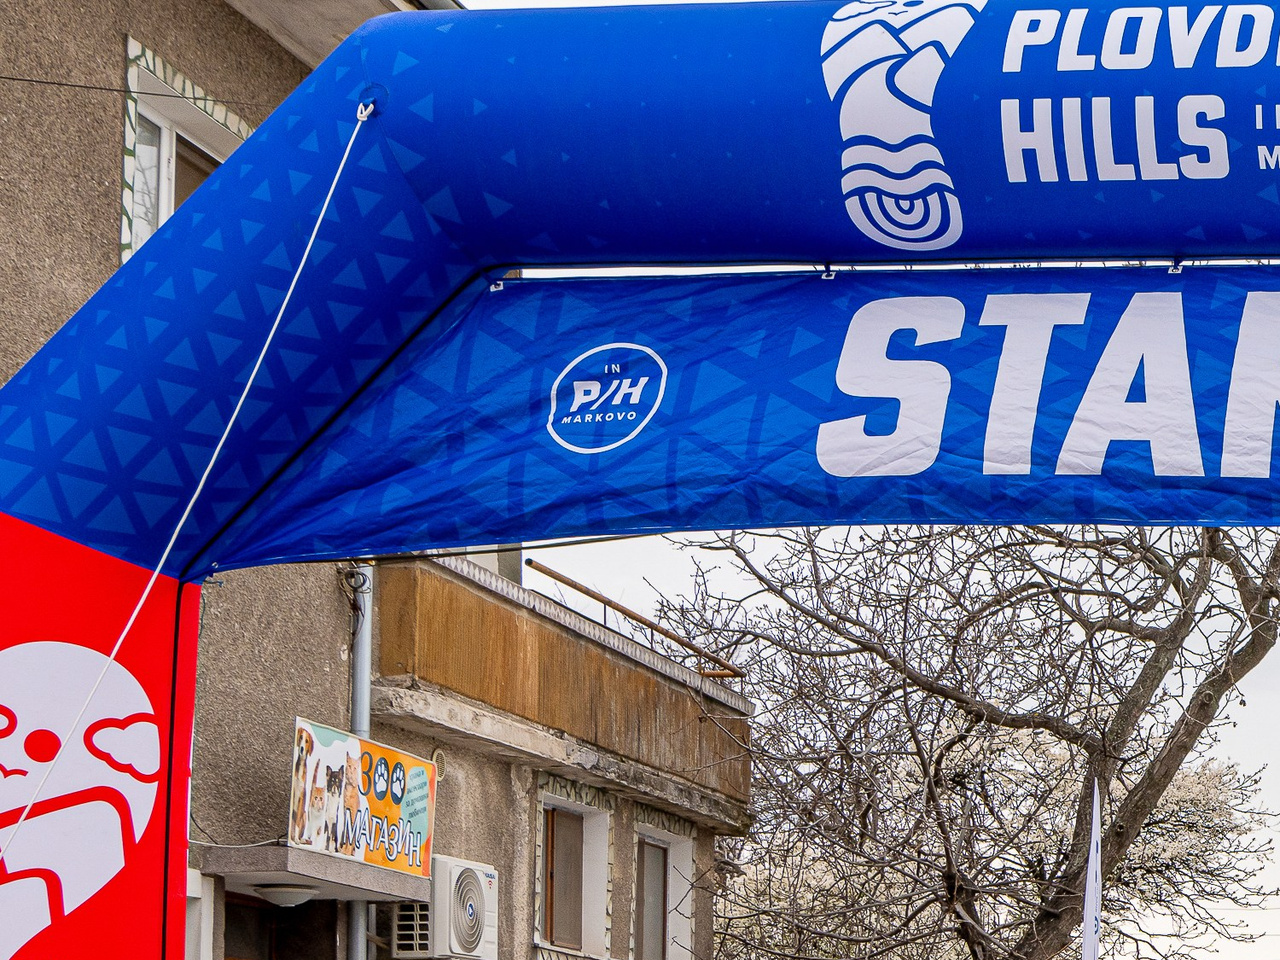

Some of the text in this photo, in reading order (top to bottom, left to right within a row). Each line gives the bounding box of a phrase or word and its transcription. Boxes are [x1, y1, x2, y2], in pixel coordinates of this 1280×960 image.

[1000, 95, 1231, 183] HILLS
[604, 364, 621, 374] IN
[569, 376, 650, 412] P/H
[561, 411, 637, 424] MARKOVO
[343, 808, 422, 867] МАГАЗИН
